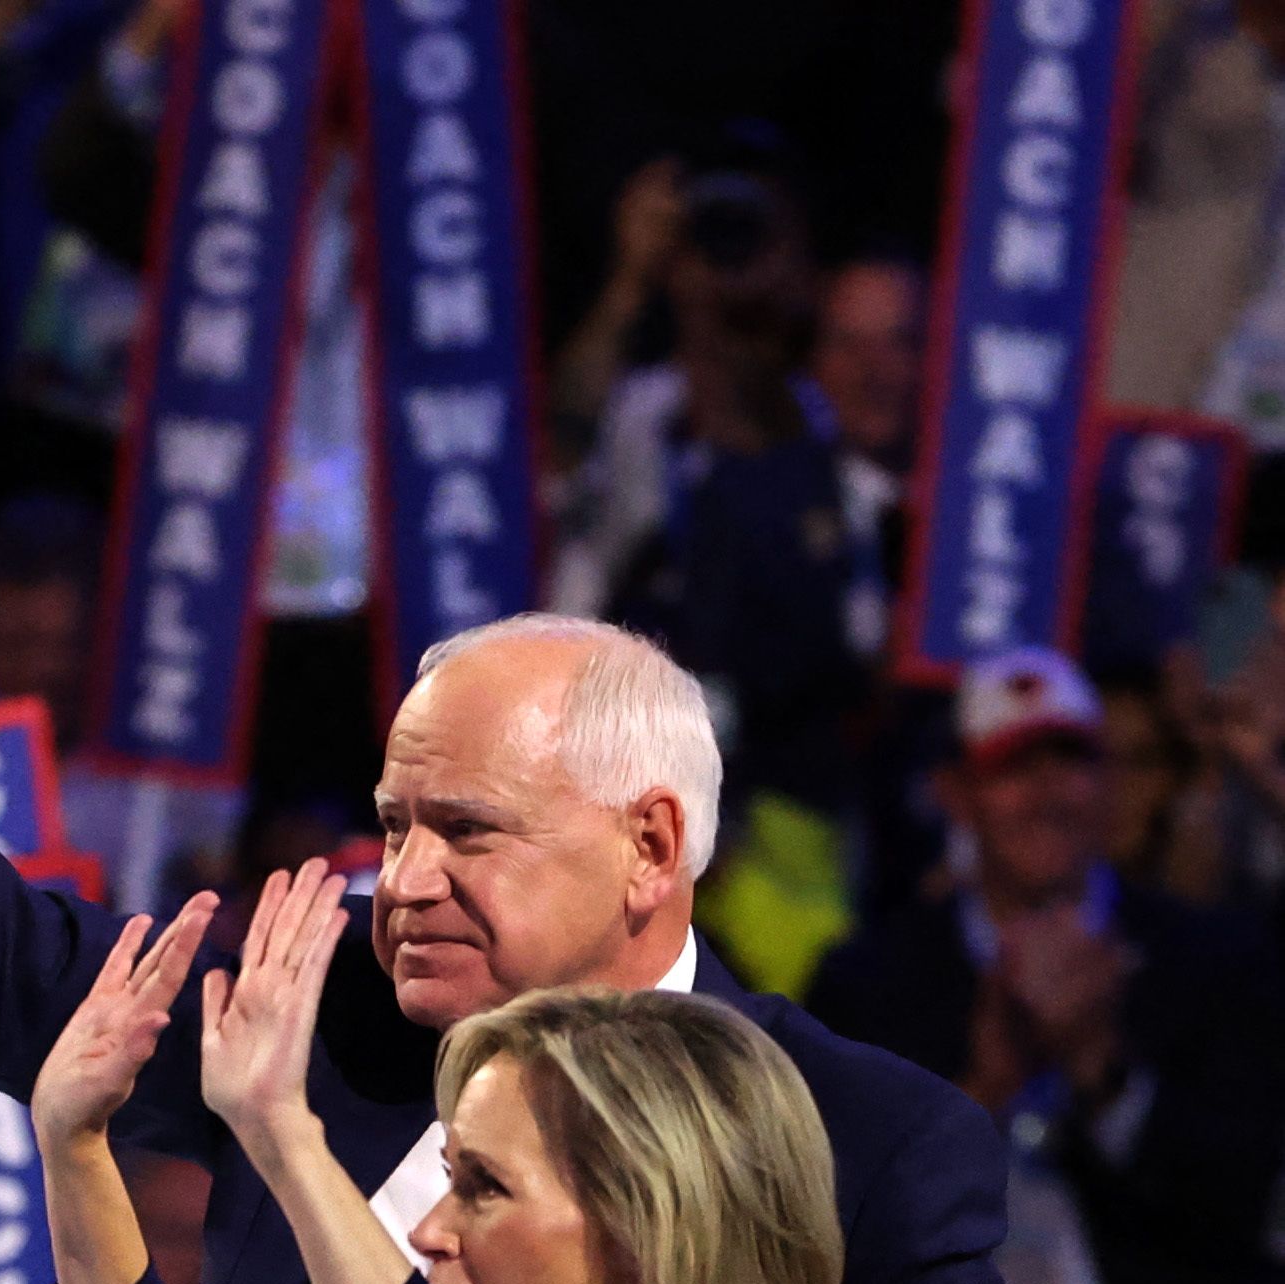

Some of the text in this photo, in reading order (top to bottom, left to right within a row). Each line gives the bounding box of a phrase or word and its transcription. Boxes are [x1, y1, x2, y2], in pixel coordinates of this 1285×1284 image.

[958, 0, 1094, 646] OACH WALZ
[132, 415, 251, 741] WALZ
[402, 386, 508, 628] WAL
